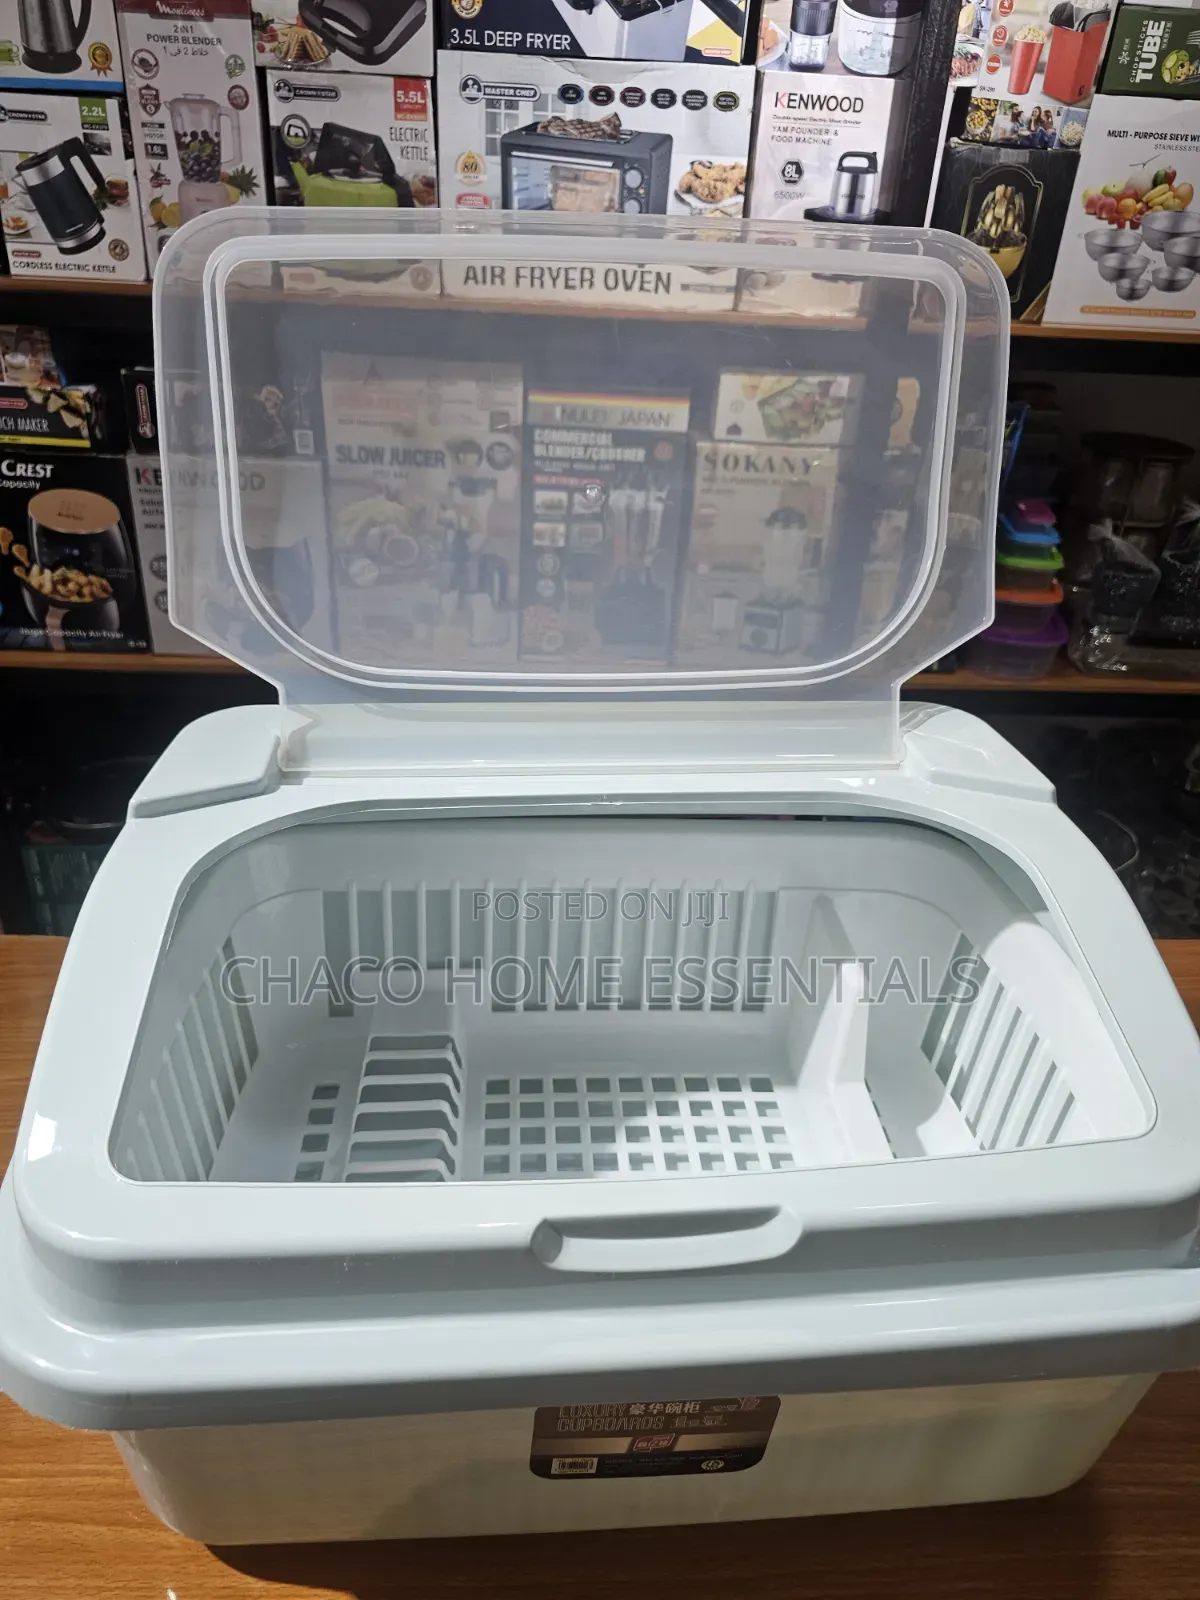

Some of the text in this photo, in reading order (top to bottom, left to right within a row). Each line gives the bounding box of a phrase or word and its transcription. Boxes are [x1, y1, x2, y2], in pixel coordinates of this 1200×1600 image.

[173, 25, 180, 33] 2
[147, 33, 222, 46] POWER BLENDER
[450, 27, 571, 50] 3.5L DEEP FRYER
[1130, 20, 1148, 83] CHOPSTICKS
[1135, 20, 1166, 83] TUBE
[396, 90, 425, 103] 5.5L
[485, 87, 535, 97] MASTER CHEF
[774, 91, 864, 113] KENWOOD
[81, 106, 106, 117] 2.2L
[390, 127, 428, 142] ELECTRIC
[772, 126, 788, 134] YAM
[791, 127, 830, 136] POUNDER
[1107, 130, 1128, 138] MULTI
[1133, 131, 1168, 140] PURPOSE
[1168, 133, 1189, 141] SIEVE
[771, 135, 832, 146] FOOD MACHINE
[400, 146, 429, 161] KETTLE
[784, 164, 799, 178] 8L
[13, 261, 116, 273] CORDLESS ELECTRIC KETTLE
[463, 265, 671, 295] AIR FRYER OVEN
[17, 417, 50, 432] MAKER
[335, 445, 446, 469] SLOW JUICER
[704, 452, 816, 476] SOKANY
[1, 459, 54, 478] CREST
[135, 467, 265, 492] KEWOD
[559, 1403, 626, 1417] LUXURY
[557, 1416, 664, 1432] CUPBOARDS
